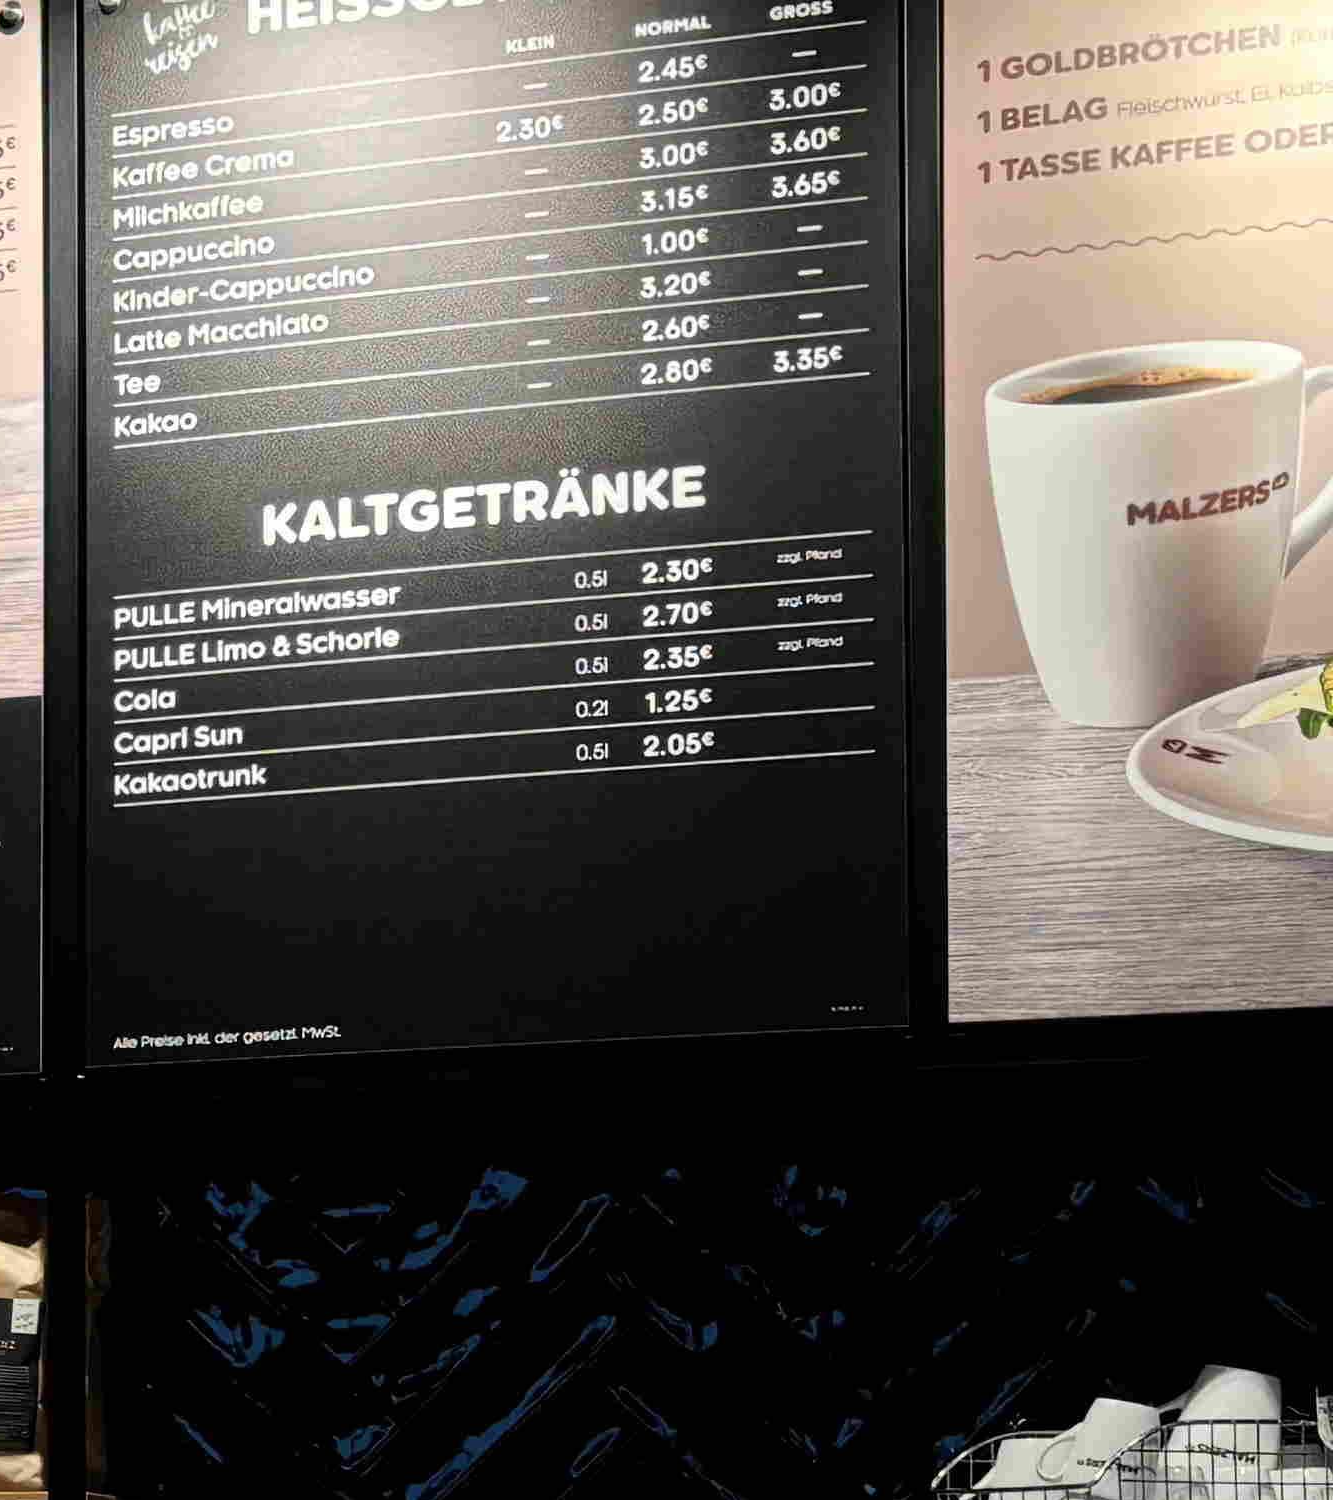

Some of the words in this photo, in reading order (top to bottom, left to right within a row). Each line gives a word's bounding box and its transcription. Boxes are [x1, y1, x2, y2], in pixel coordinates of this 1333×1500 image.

[505, 34, 555, 54] KLEIN
[635, 16, 712, 38] NORMAL
[769, 1, 834, 21] GROSS
[977, 59, 991, 83] 1
[1001, 24, 1281, 79] GOLDBRÖTCHEN
[112, 116, 234, 147] Espresso
[638, 54, 708, 83] 2.45€
[112, 161, 198, 188] Kaffee
[205, 149, 294, 177] Crema
[495, 115, 564, 142] 2.30€
[638, 98, 708, 127] 2.50€
[769, 82, 841, 112] 3.00€
[977, 110, 991, 133] 1
[1001, 98, 1107, 132] BELAG
[113, 195, 263, 230] Milchkaffee
[639, 141, 708, 169] 3.00€
[770, 126, 841, 155] 3.60€
[977, 161, 991, 184] 1
[1001, 148, 1102, 182] TASSE
[1111, 132, 1234, 169] KAFFEE
[1245, 121, 1333, 153] ODER
[113, 235, 275, 272] Cappuccino
[641, 184, 708, 213] 3.15€
[771, 170, 841, 199] 3.65€
[113, 265, 375, 313] Kinder-Cappuccino
[641, 228, 709, 256] 1.00€
[114, 328, 182, 355] Latte
[188, 313, 329, 346] Macchiato
[641, 271, 711, 299] 3.20€
[113, 373, 161, 396] Tee
[642, 314, 711, 342] 2.60€
[114, 411, 198, 438] Kakao
[641, 357, 712, 386] 2.80€
[773, 345, 843, 374] 3.35€
[262, 464, 707, 548] KALTGETRÄNKE
[1126, 480, 1271, 526] MALZERS
[114, 601, 195, 630] PULLE
[202, 586, 401, 622] Mineralwasser
[641, 557, 713, 584] 2.30€
[114, 643, 195, 671] PULLE
[202, 640, 266, 664] Limo
[273, 635, 291, 657] &
[296, 626, 400, 655] Schorle
[643, 601, 713, 628] 2.70€
[114, 689, 176, 712] Cola
[643, 644, 713, 671] 2.35€
[114, 727, 188, 754] Capri
[194, 725, 243, 748] Sun
[645, 688, 713, 714] 1.25€
[114, 763, 267, 796] Kakaotrunk
[643, 731, 715, 758] 2.05€
